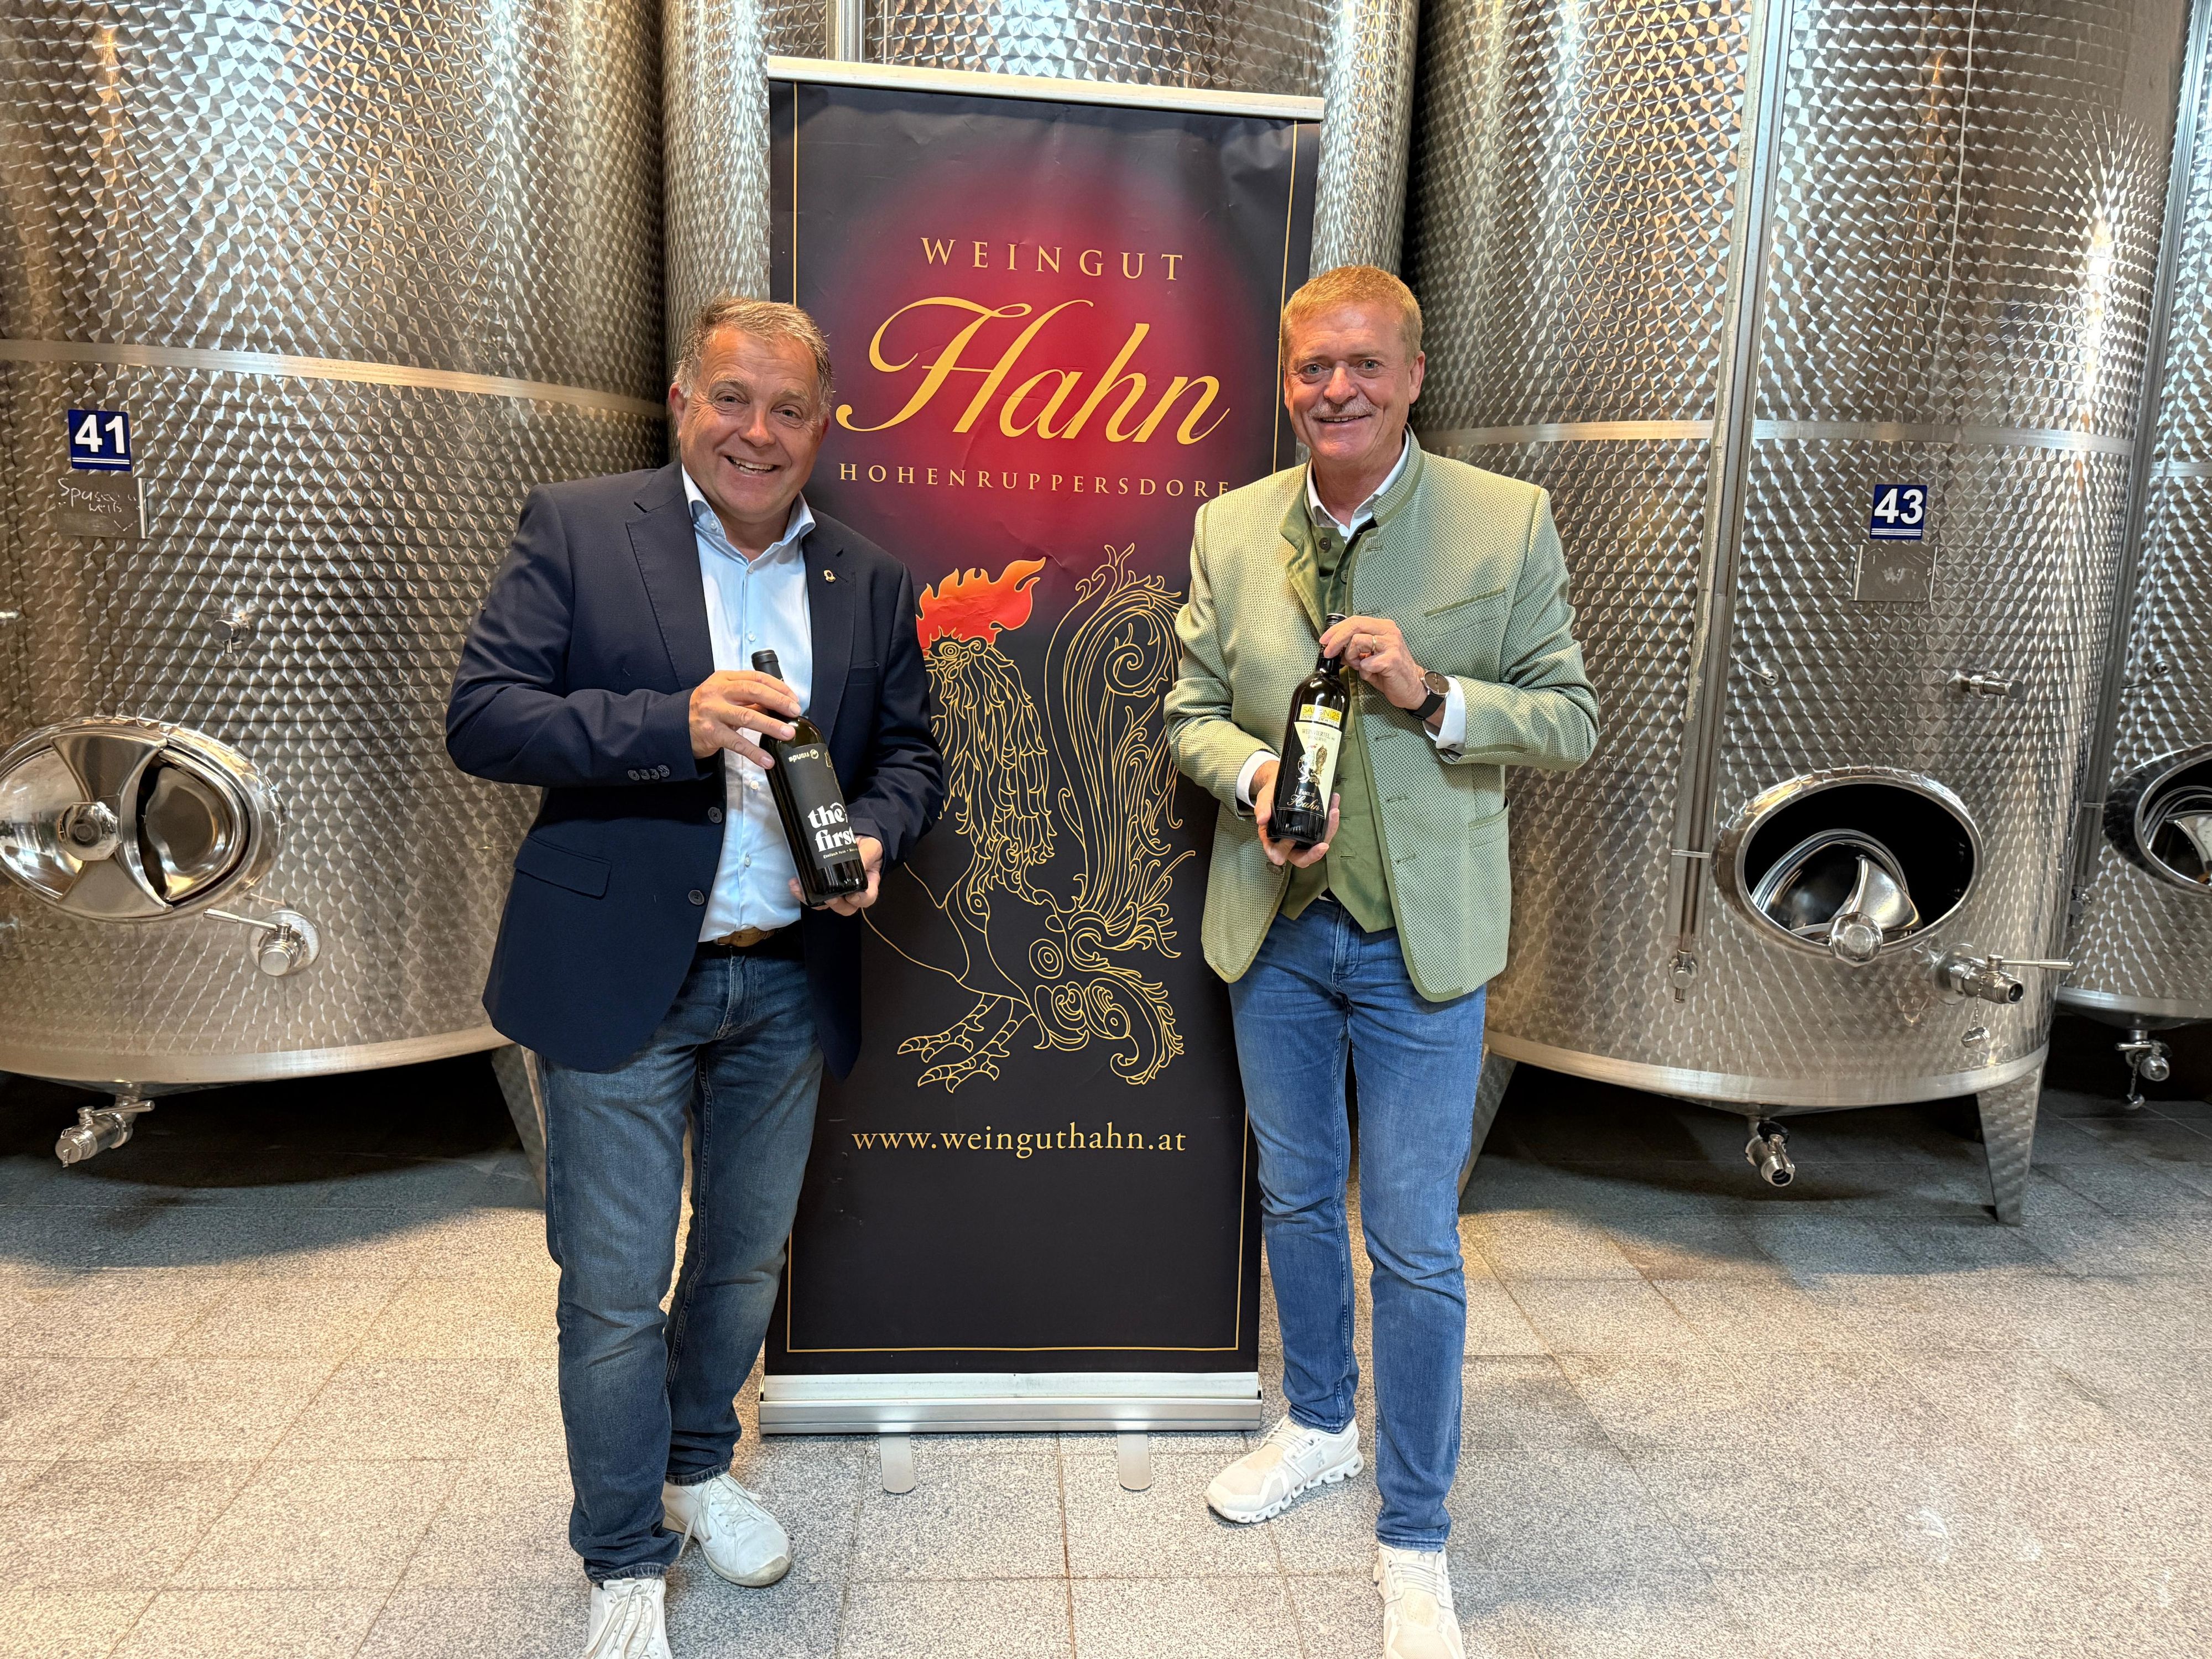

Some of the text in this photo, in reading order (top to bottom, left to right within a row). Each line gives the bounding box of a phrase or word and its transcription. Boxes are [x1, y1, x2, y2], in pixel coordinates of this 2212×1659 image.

[920, 237, 1183, 281] WEINGUT
[836, 296, 1231, 445] Hahn
[75, 414, 125, 454] 41
[839, 463, 1228, 497] HOHENRUPPERSDORF
[1874, 488, 1923, 524] 43
[1302, 707, 1340, 721] SAON 25
[807, 805, 845, 828] the
[1286, 794, 1319, 811] Hahn
[815, 826, 857, 852] first
[852, 1121, 1187, 1159] www.weinguthahn.at
